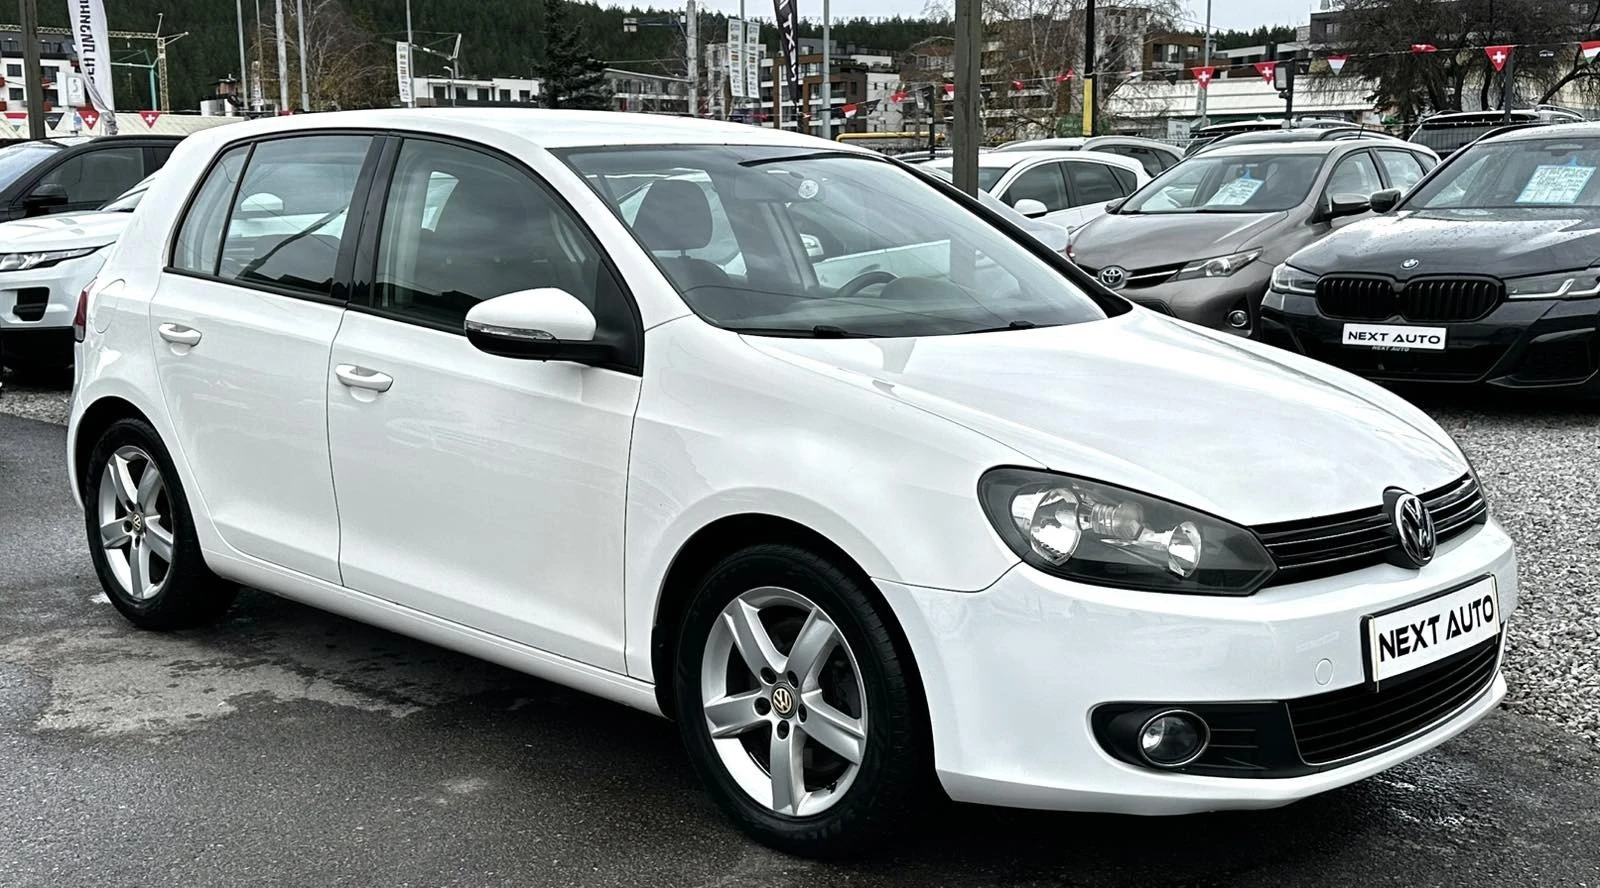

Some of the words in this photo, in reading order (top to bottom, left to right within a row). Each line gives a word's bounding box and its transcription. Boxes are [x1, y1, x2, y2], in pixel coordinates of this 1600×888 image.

[1348, 331, 1389, 342] NEXT
[1392, 333, 1441, 345] AUTO
[1379, 614, 1441, 662] NEXT
[1446, 595, 1494, 640] AUTO
